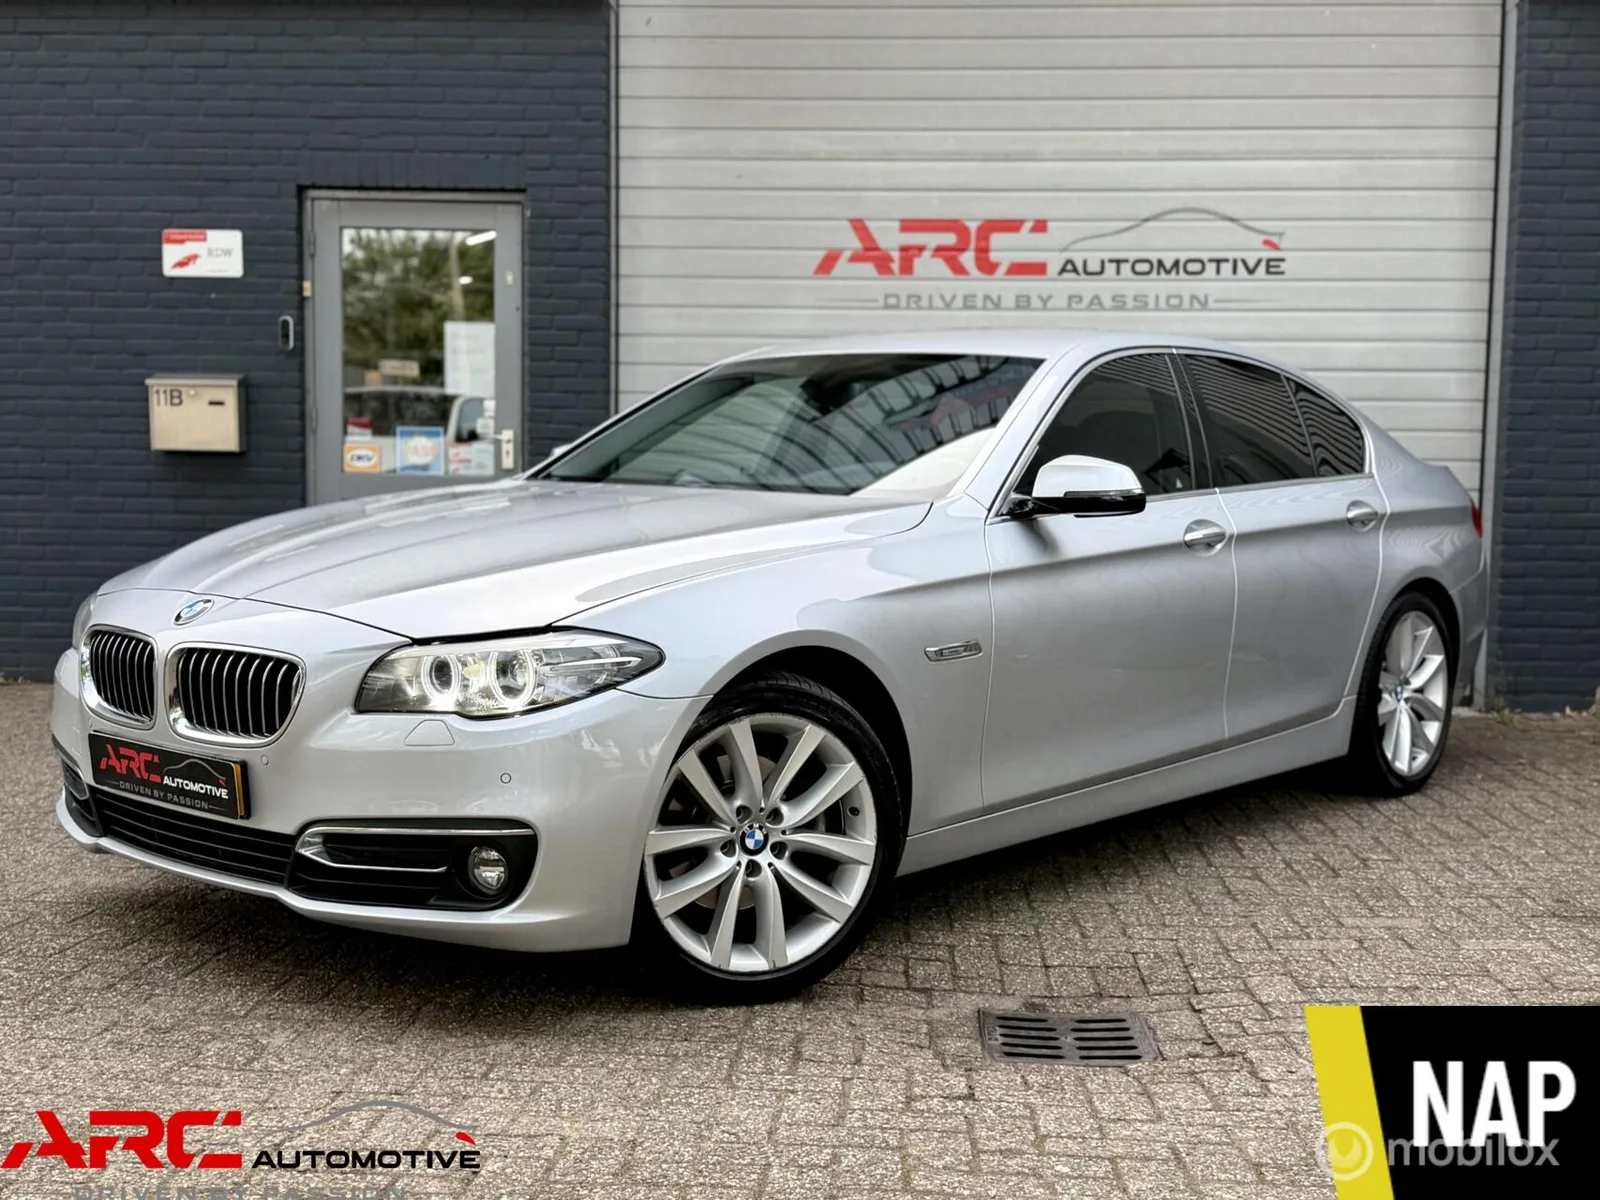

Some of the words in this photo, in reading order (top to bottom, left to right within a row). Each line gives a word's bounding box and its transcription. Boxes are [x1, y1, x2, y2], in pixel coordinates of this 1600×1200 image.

[813, 218, 1048, 276] ARC
[1058, 258, 1286, 276] AUTOMOTIVE
[884, 294, 1002, 310] DRIVEN
[1015, 294, 1053, 310] BY
[1067, 294, 1209, 310] PASSION
[155, 389, 183, 407] 11B
[100, 743, 162, 783] ARC
[163, 775, 229, 799] AUTOMOTIVE
[119, 780, 151, 796] DRIVEN
[153, 790, 166, 800] BY
[167, 793, 209, 810] PASSION
